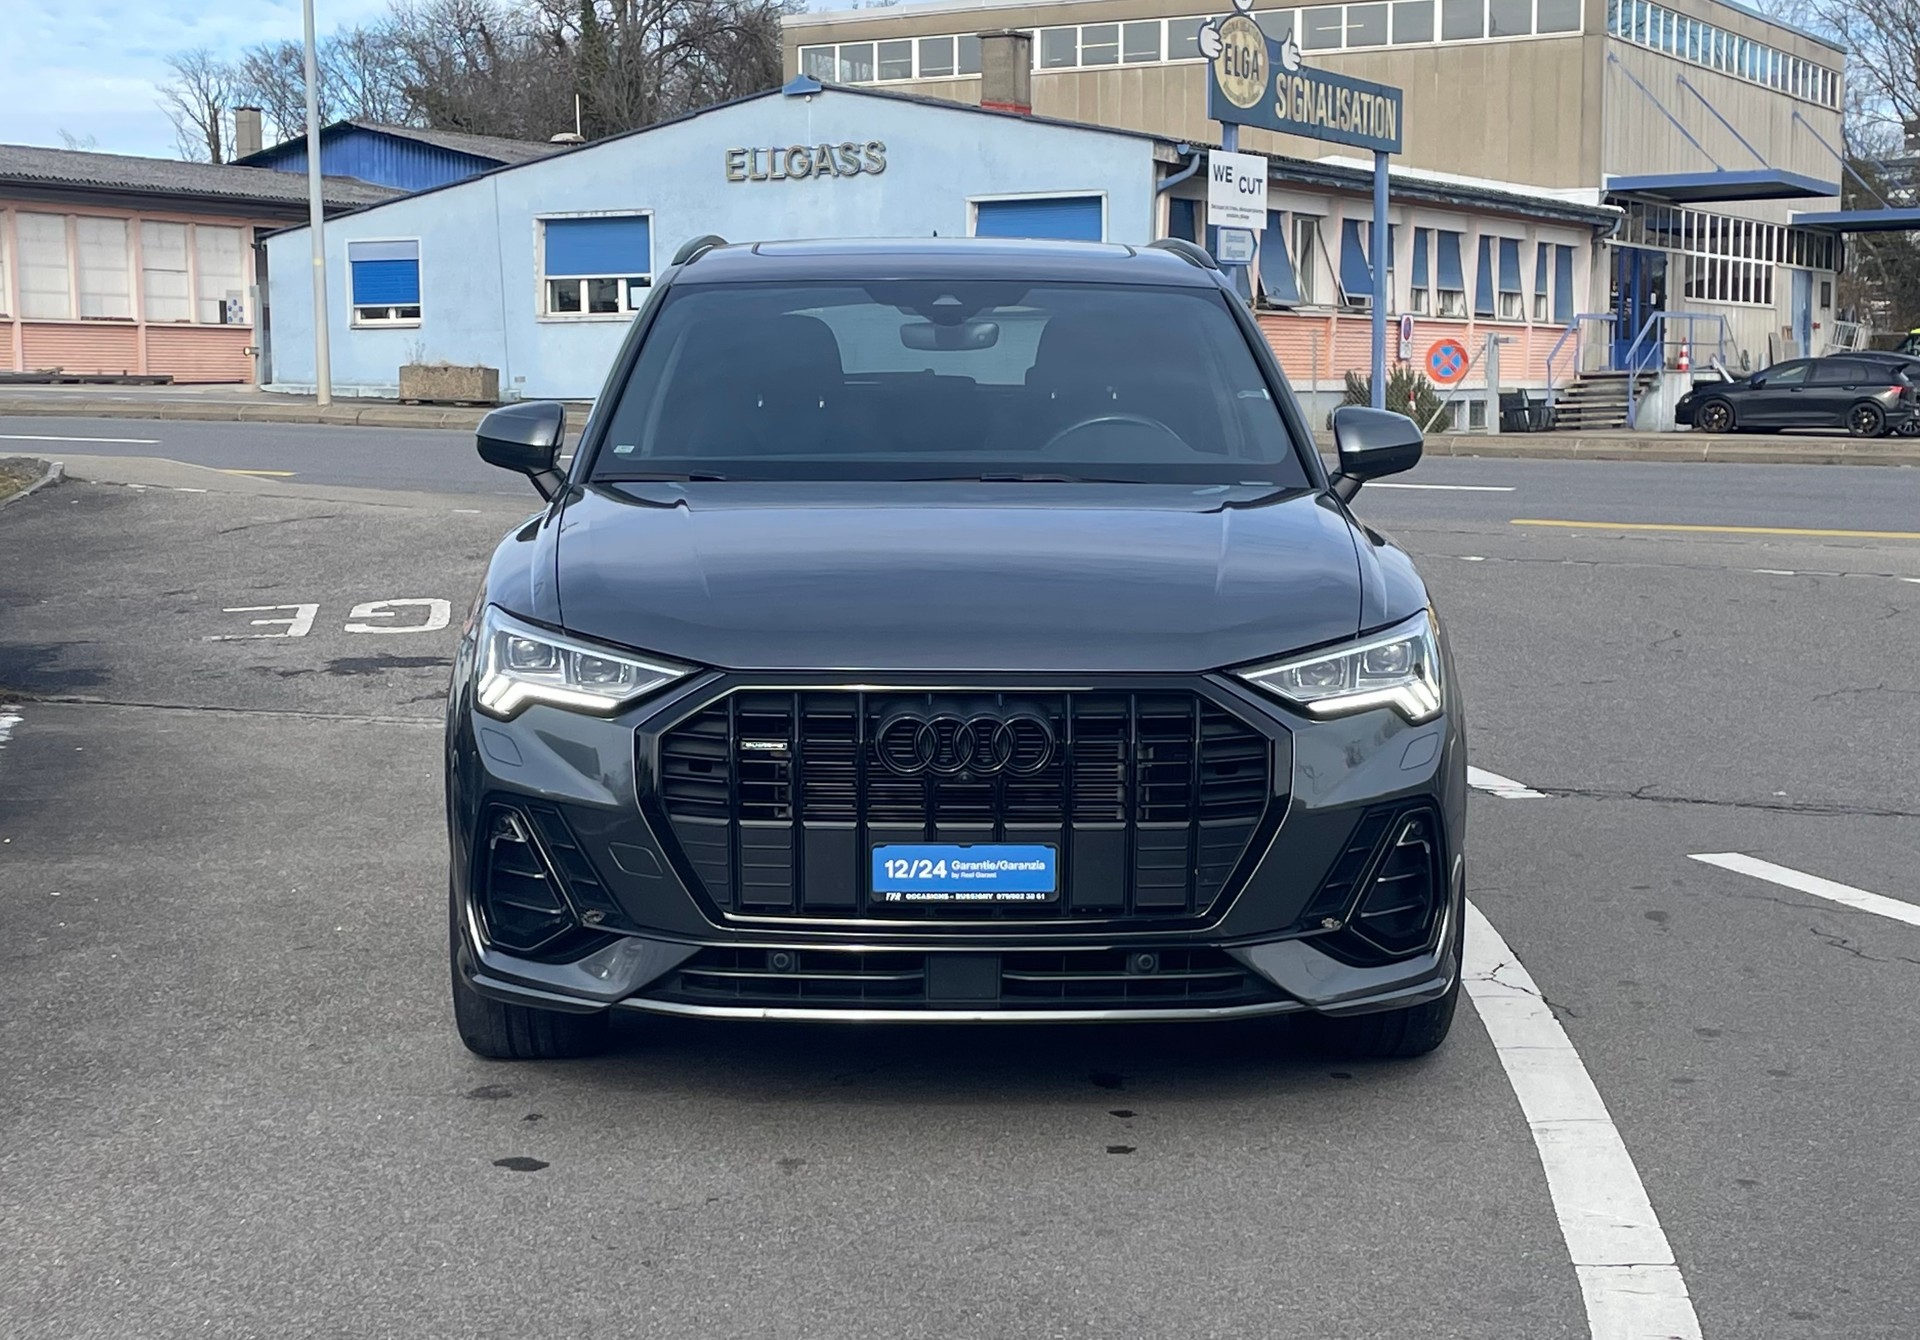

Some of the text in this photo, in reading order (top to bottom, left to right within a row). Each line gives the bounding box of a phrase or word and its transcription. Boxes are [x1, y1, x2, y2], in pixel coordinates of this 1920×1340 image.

[1224, 43, 1260, 81] ELGA
[1275, 72, 1396, 141] SIGNALISATION
[725, 140, 887, 181] ELLGASS
[1213, 163, 1263, 196] WE CUT
[884, 859, 1046, 879] 12/24 Garantie/Garanzia
